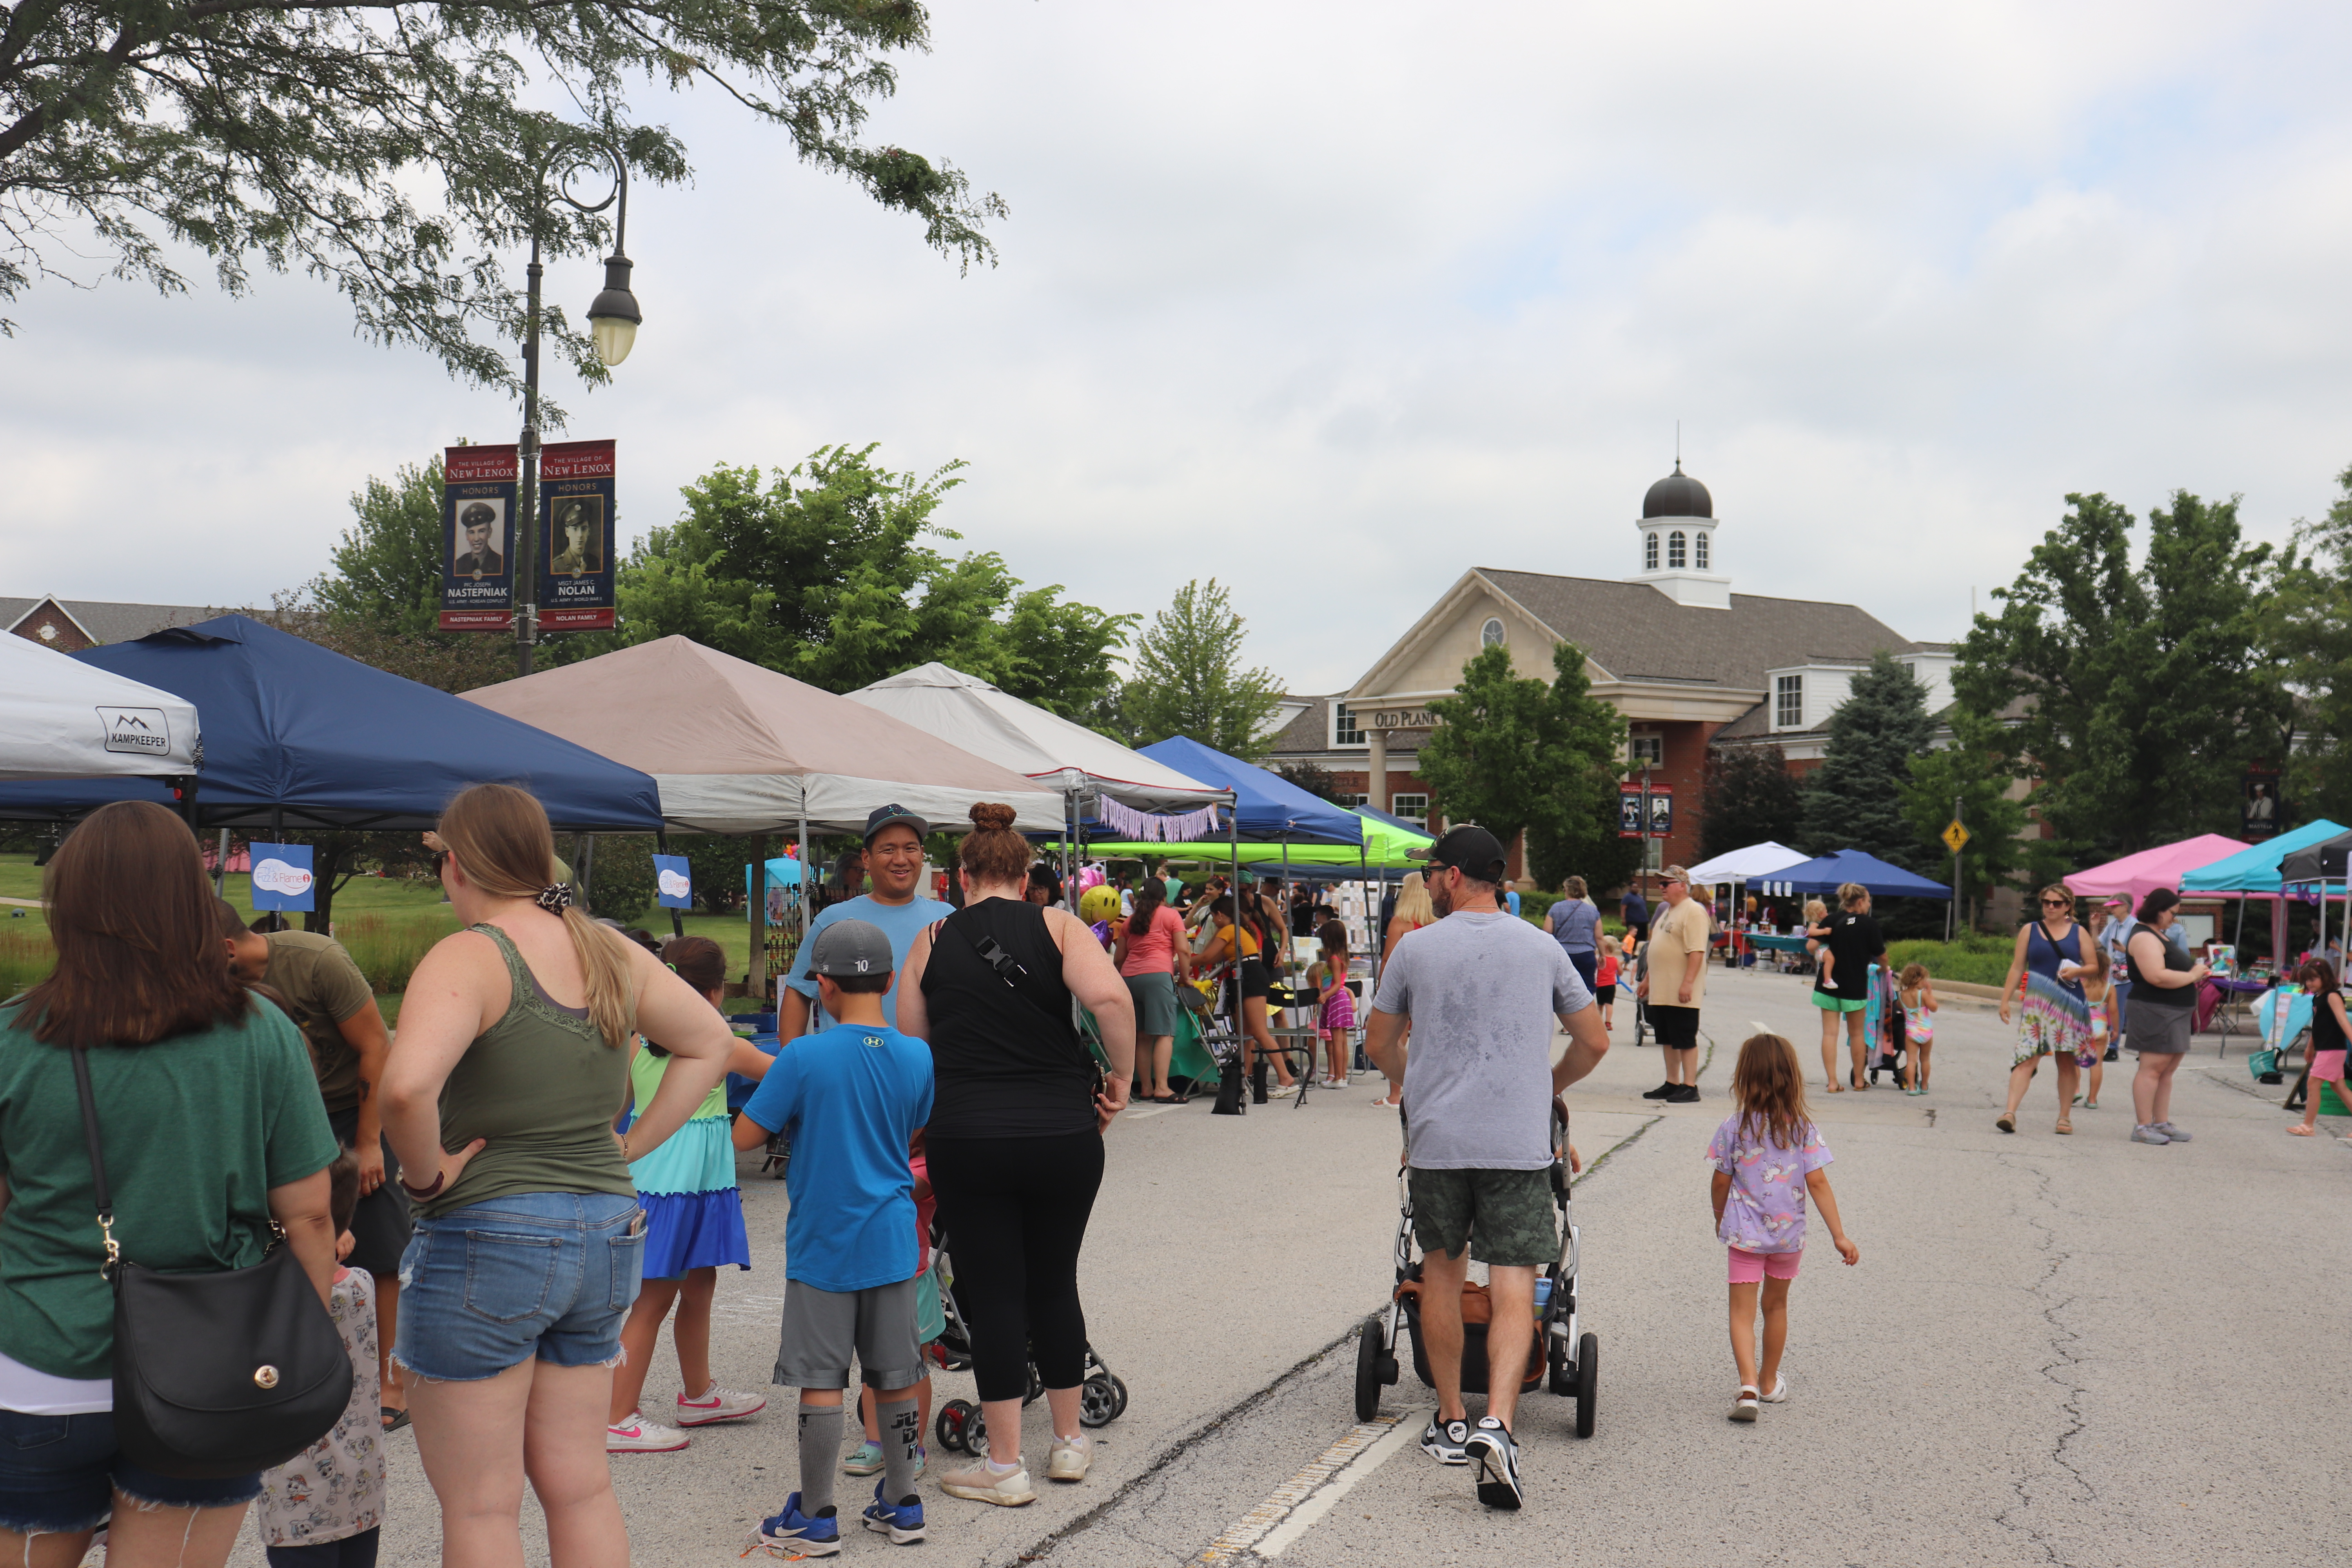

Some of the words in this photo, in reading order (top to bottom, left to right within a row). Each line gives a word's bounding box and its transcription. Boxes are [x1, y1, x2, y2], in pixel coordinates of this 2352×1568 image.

[449, 469, 474, 478] NEW
[476, 468, 514, 477] LENOX
[544, 466, 570, 475] NEW
[573, 464, 611, 474] LENOX
[462, 486, 499, 495] HONORS
[559, 483, 597, 492] HONORS
[448, 588, 508, 597] NASTEPNIAK
[558, 586, 595, 595] NOLAN
[1375, 712, 1398, 727] OLD
[1401, 711, 1438, 726] PLANK
[111, 733, 166, 747] KAMPKEEPER
[1111, 805, 1153, 833] MAGICAL
[1165, 810, 1215, 835] CREATIONS
[257, 872, 271, 882] Fizz
[272, 873, 278, 882] &
[279, 873, 302, 883] Flame
[669, 880, 673, 888] &
[855, 960, 869, 972] 10
